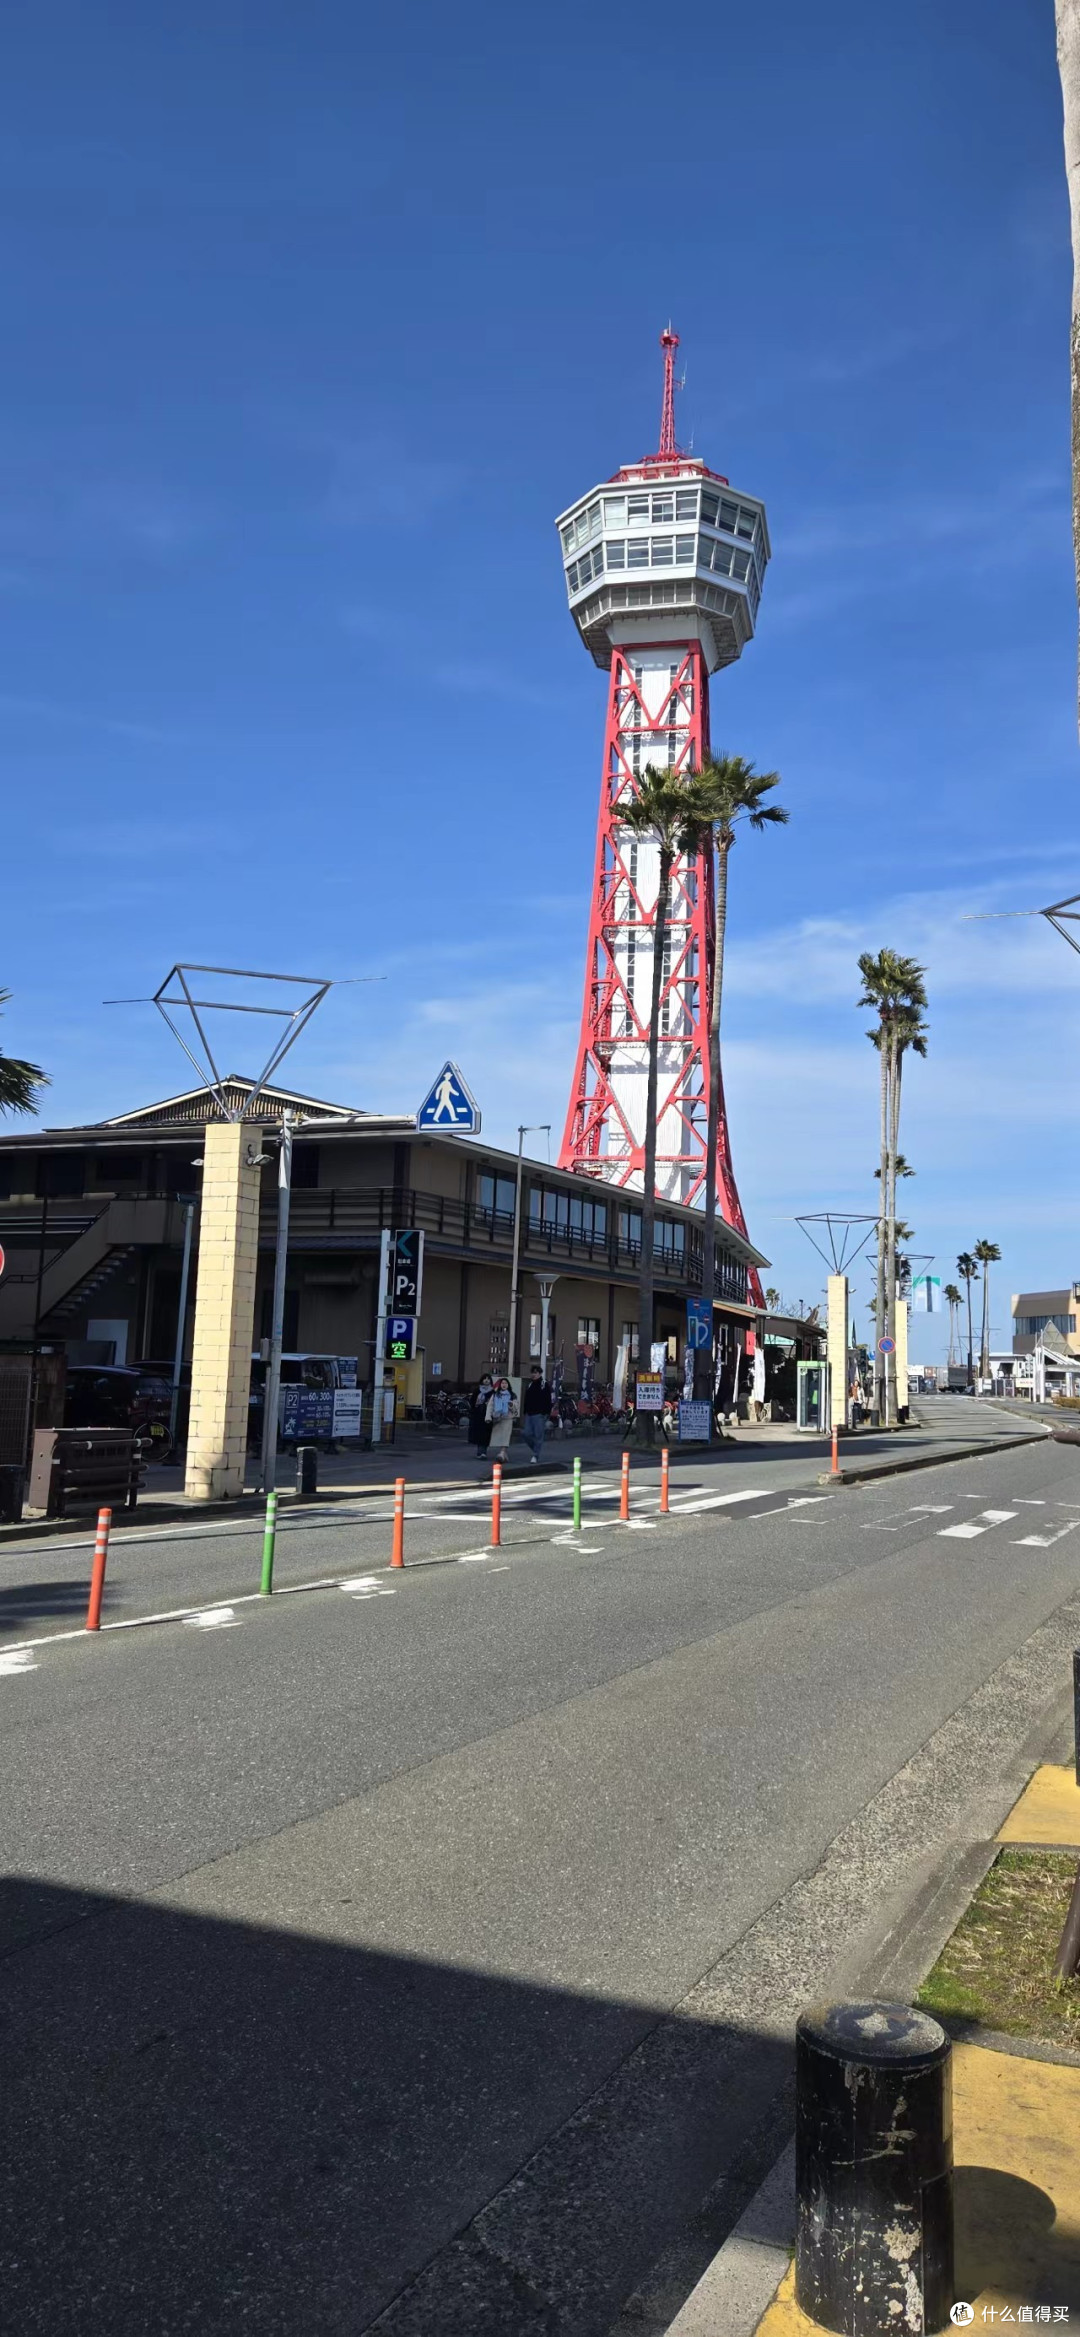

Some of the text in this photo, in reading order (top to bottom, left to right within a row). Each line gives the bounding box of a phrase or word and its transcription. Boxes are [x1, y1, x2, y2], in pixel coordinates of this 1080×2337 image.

[396, 1275, 415, 1296] P2
[392, 1320, 407, 1338] P
[391, 1341, 407, 1358] 空
[287, 1394, 298, 1406] P2
